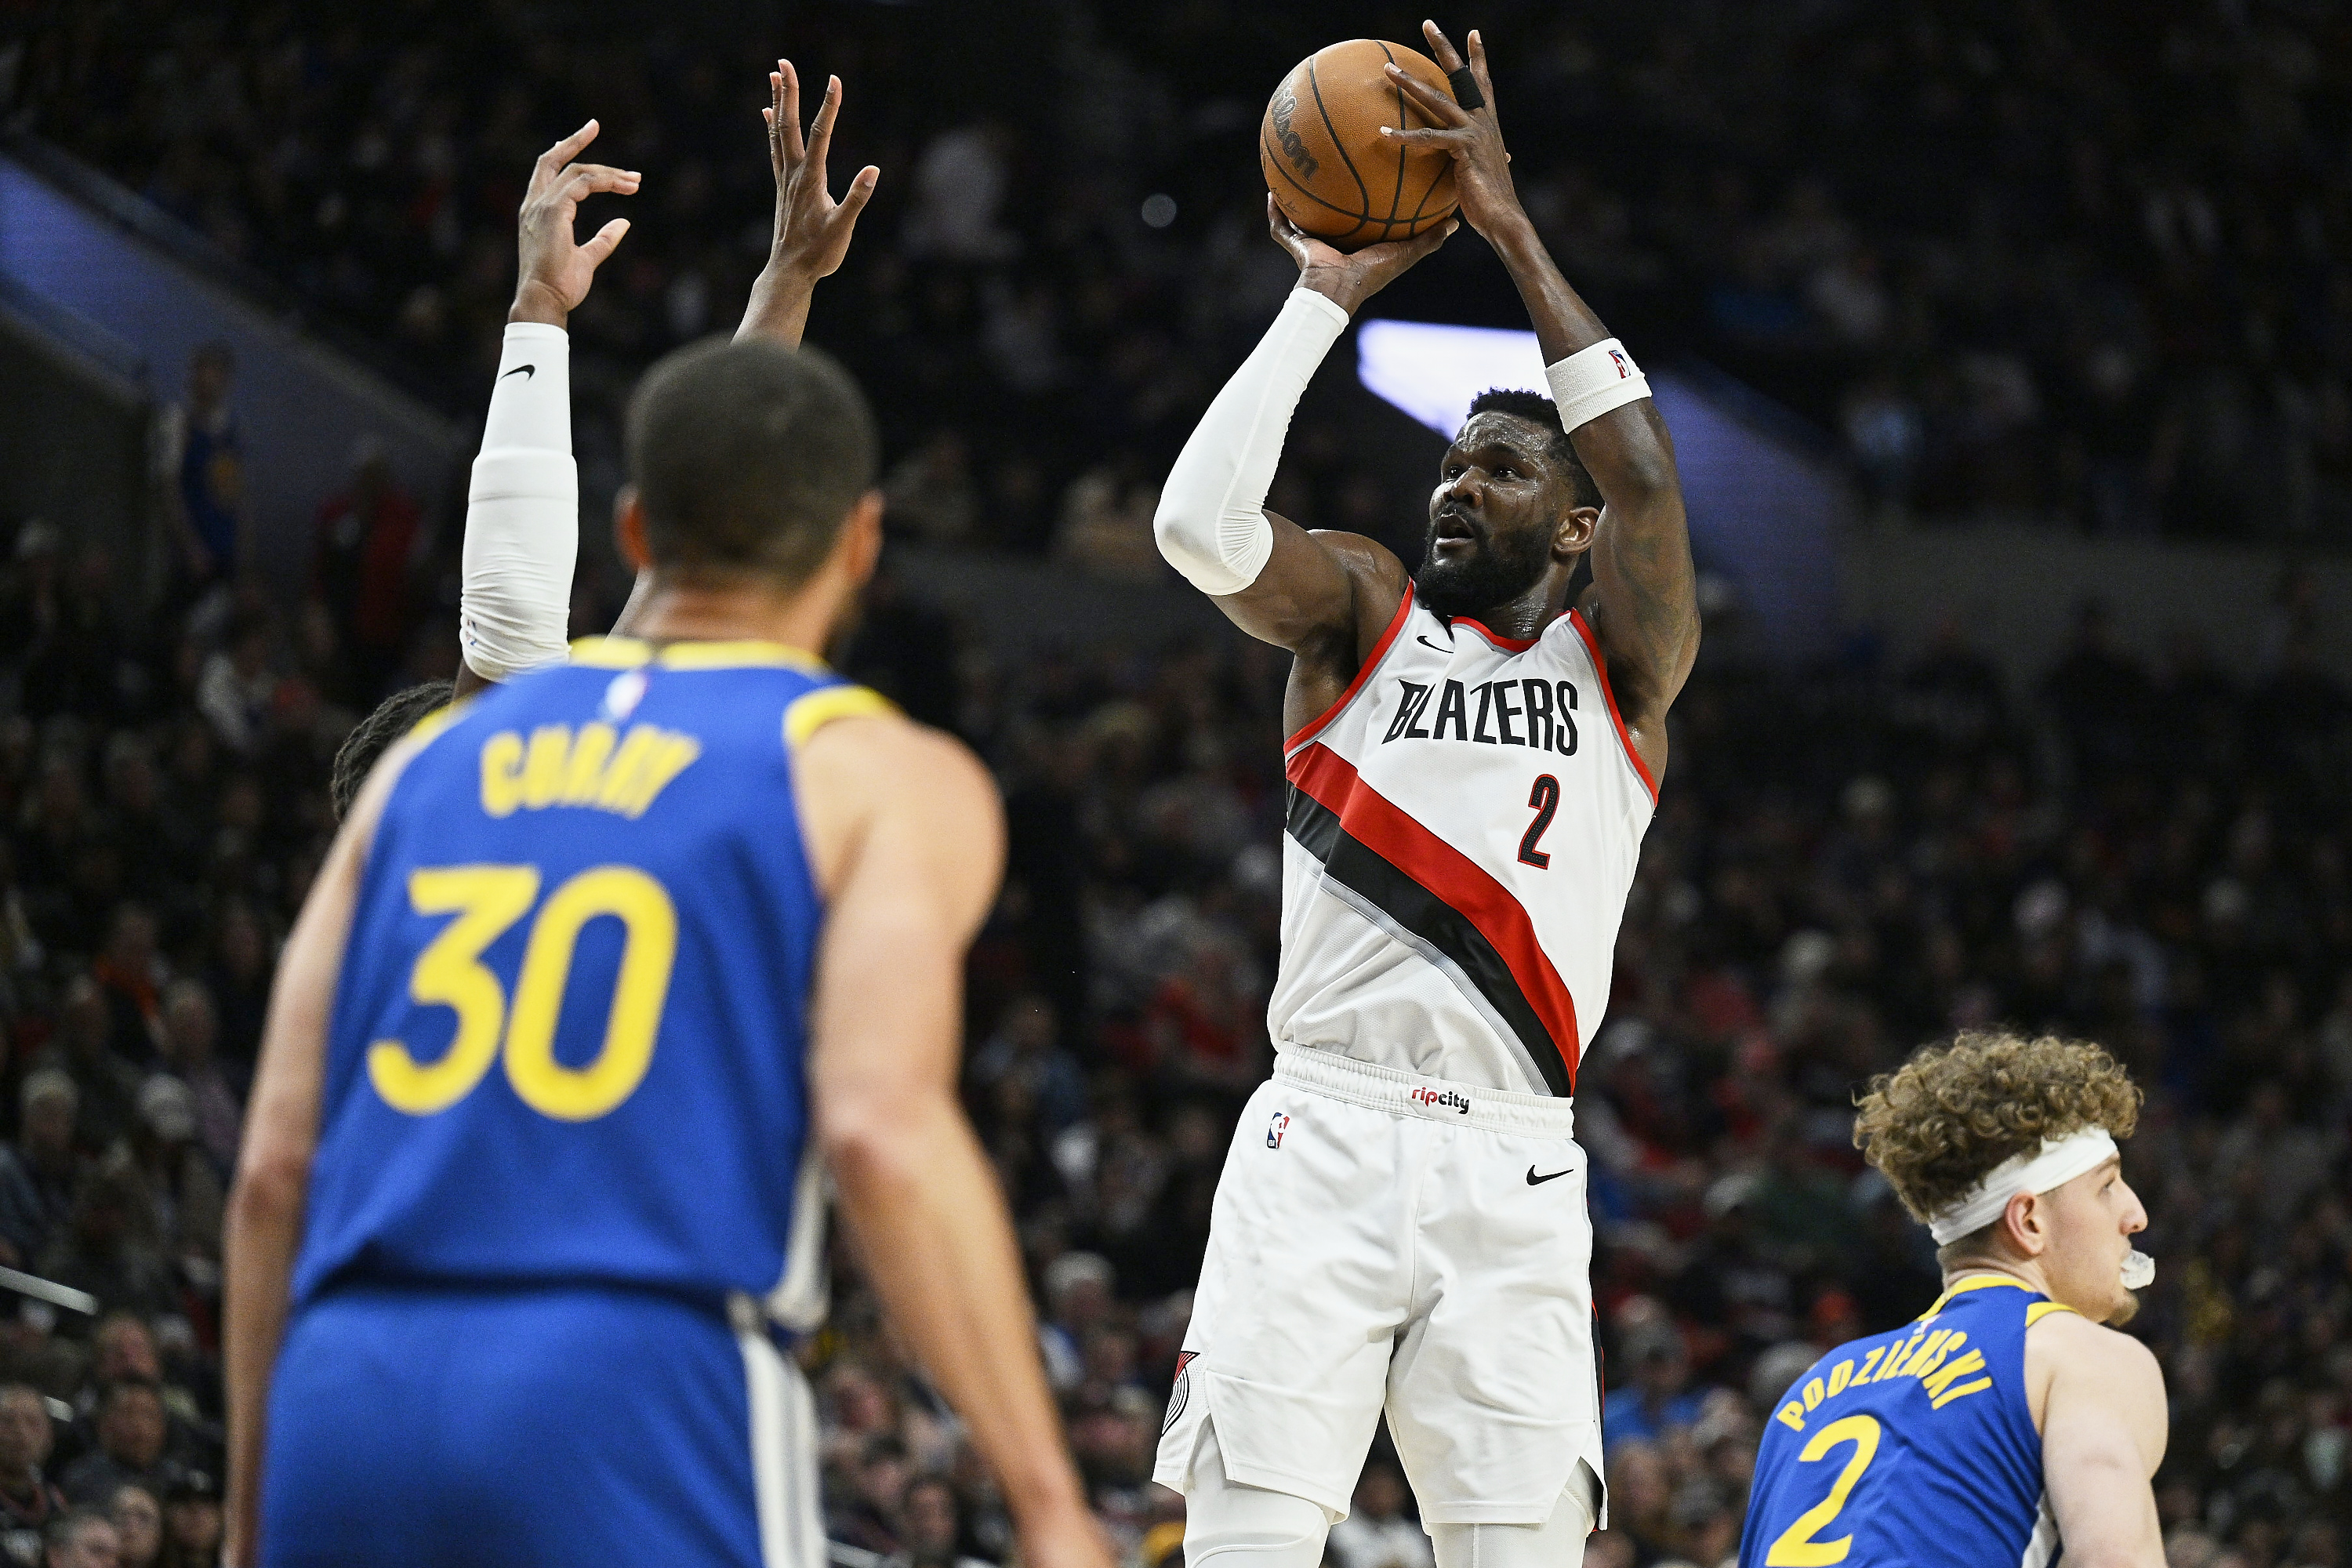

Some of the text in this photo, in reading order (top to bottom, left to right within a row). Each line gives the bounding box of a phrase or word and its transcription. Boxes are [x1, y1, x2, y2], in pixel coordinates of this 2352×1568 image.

[1381, 678, 1578, 756] BLAZERS
[480, 723, 700, 818] CURRY
[1517, 774, 1560, 869] 2
[368, 866, 678, 1122] 30
[1411, 1087, 1470, 1115] ripcity
[1765, 1414, 1881, 1567] 2
